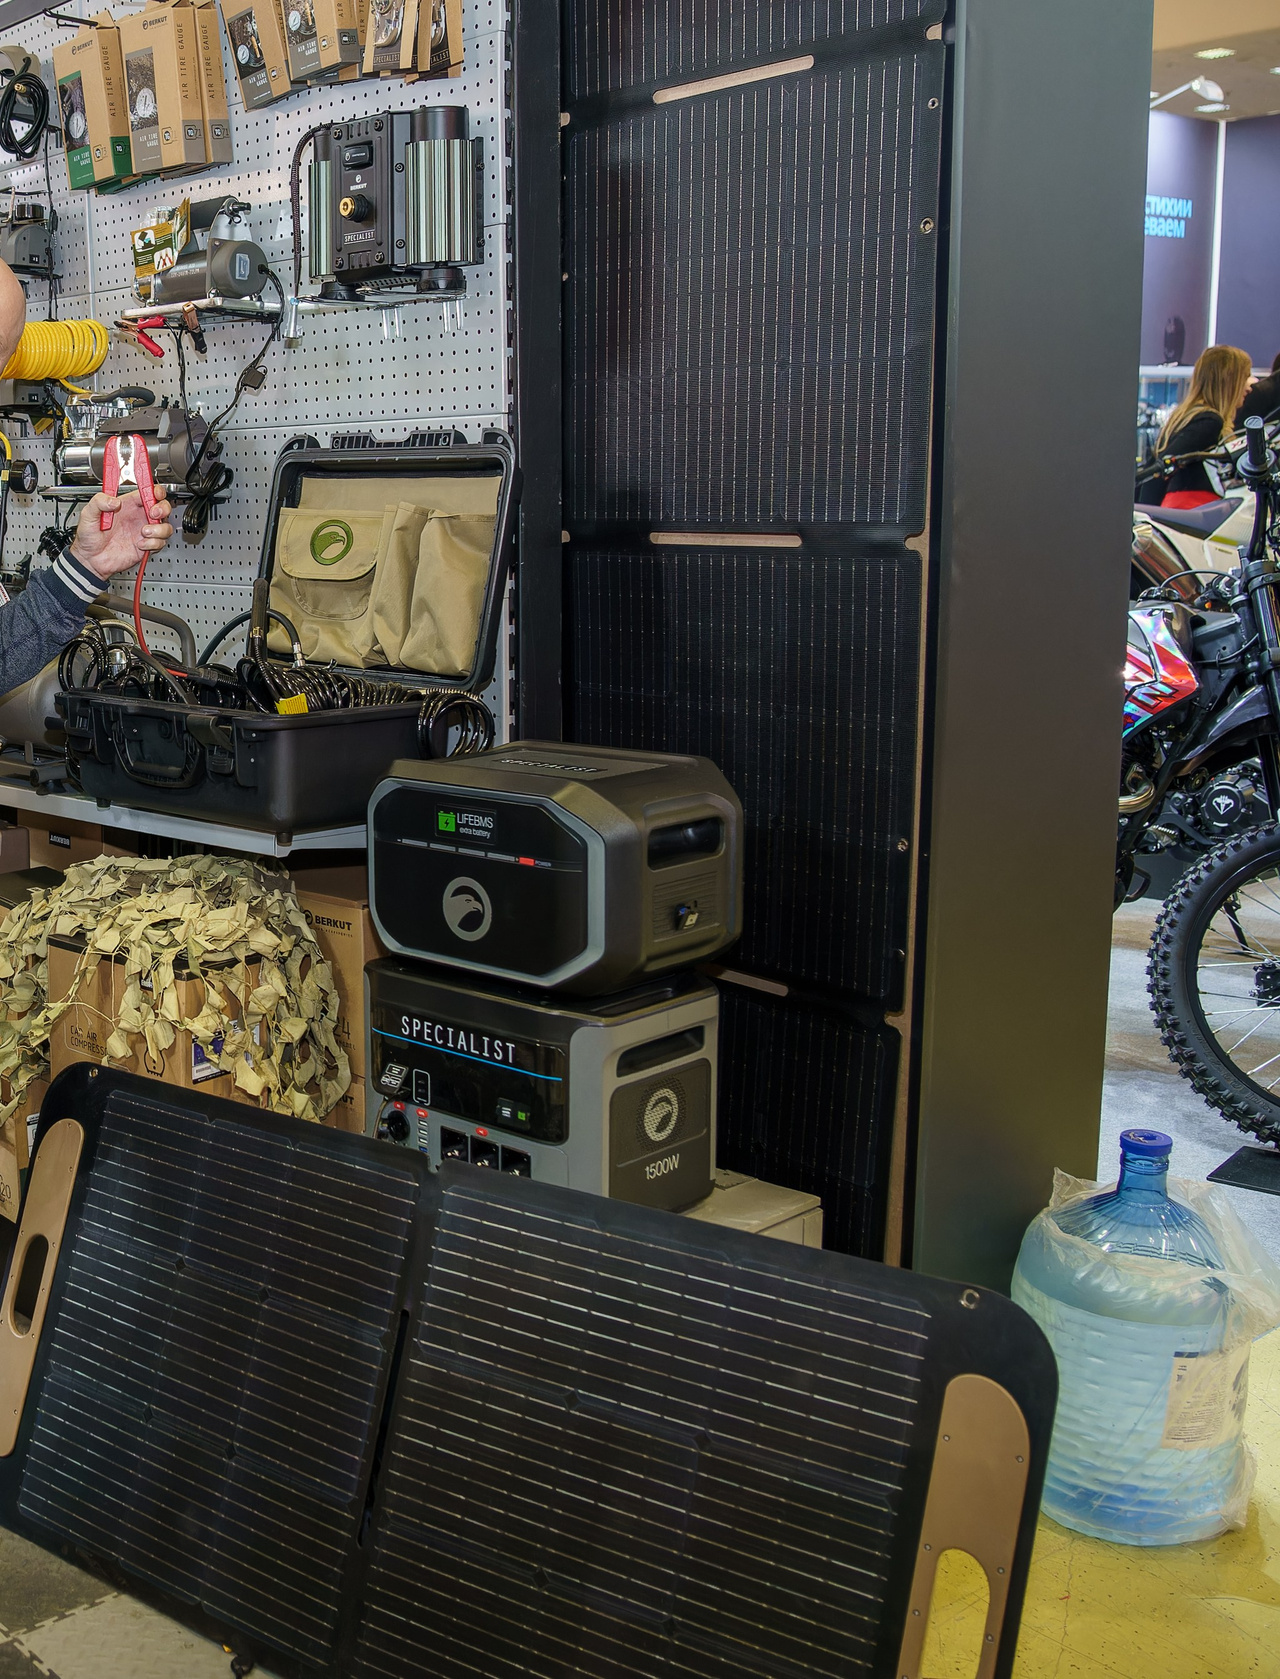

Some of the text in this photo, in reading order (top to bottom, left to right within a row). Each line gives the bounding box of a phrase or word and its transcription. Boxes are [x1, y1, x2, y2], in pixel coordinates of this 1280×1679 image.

[201, 24, 216, 99] AIR TIRE GAUGE
[101, 45, 117, 117] AIR TIRE GAUGE
[181, 82, 189, 99] AIR
[344, 231, 375, 242] SPECIALIST
[501, 758, 599, 773] SPECIALIST
[456, 812, 494, 829] LIFEBMS
[472, 828, 492, 840] battery
[315, 915, 353, 931] BERKUT
[86, 1030, 98, 1042] AIR
[401, 1015, 516, 1064] SPECIALIST
[644, 1153, 680, 1180] 1500W
